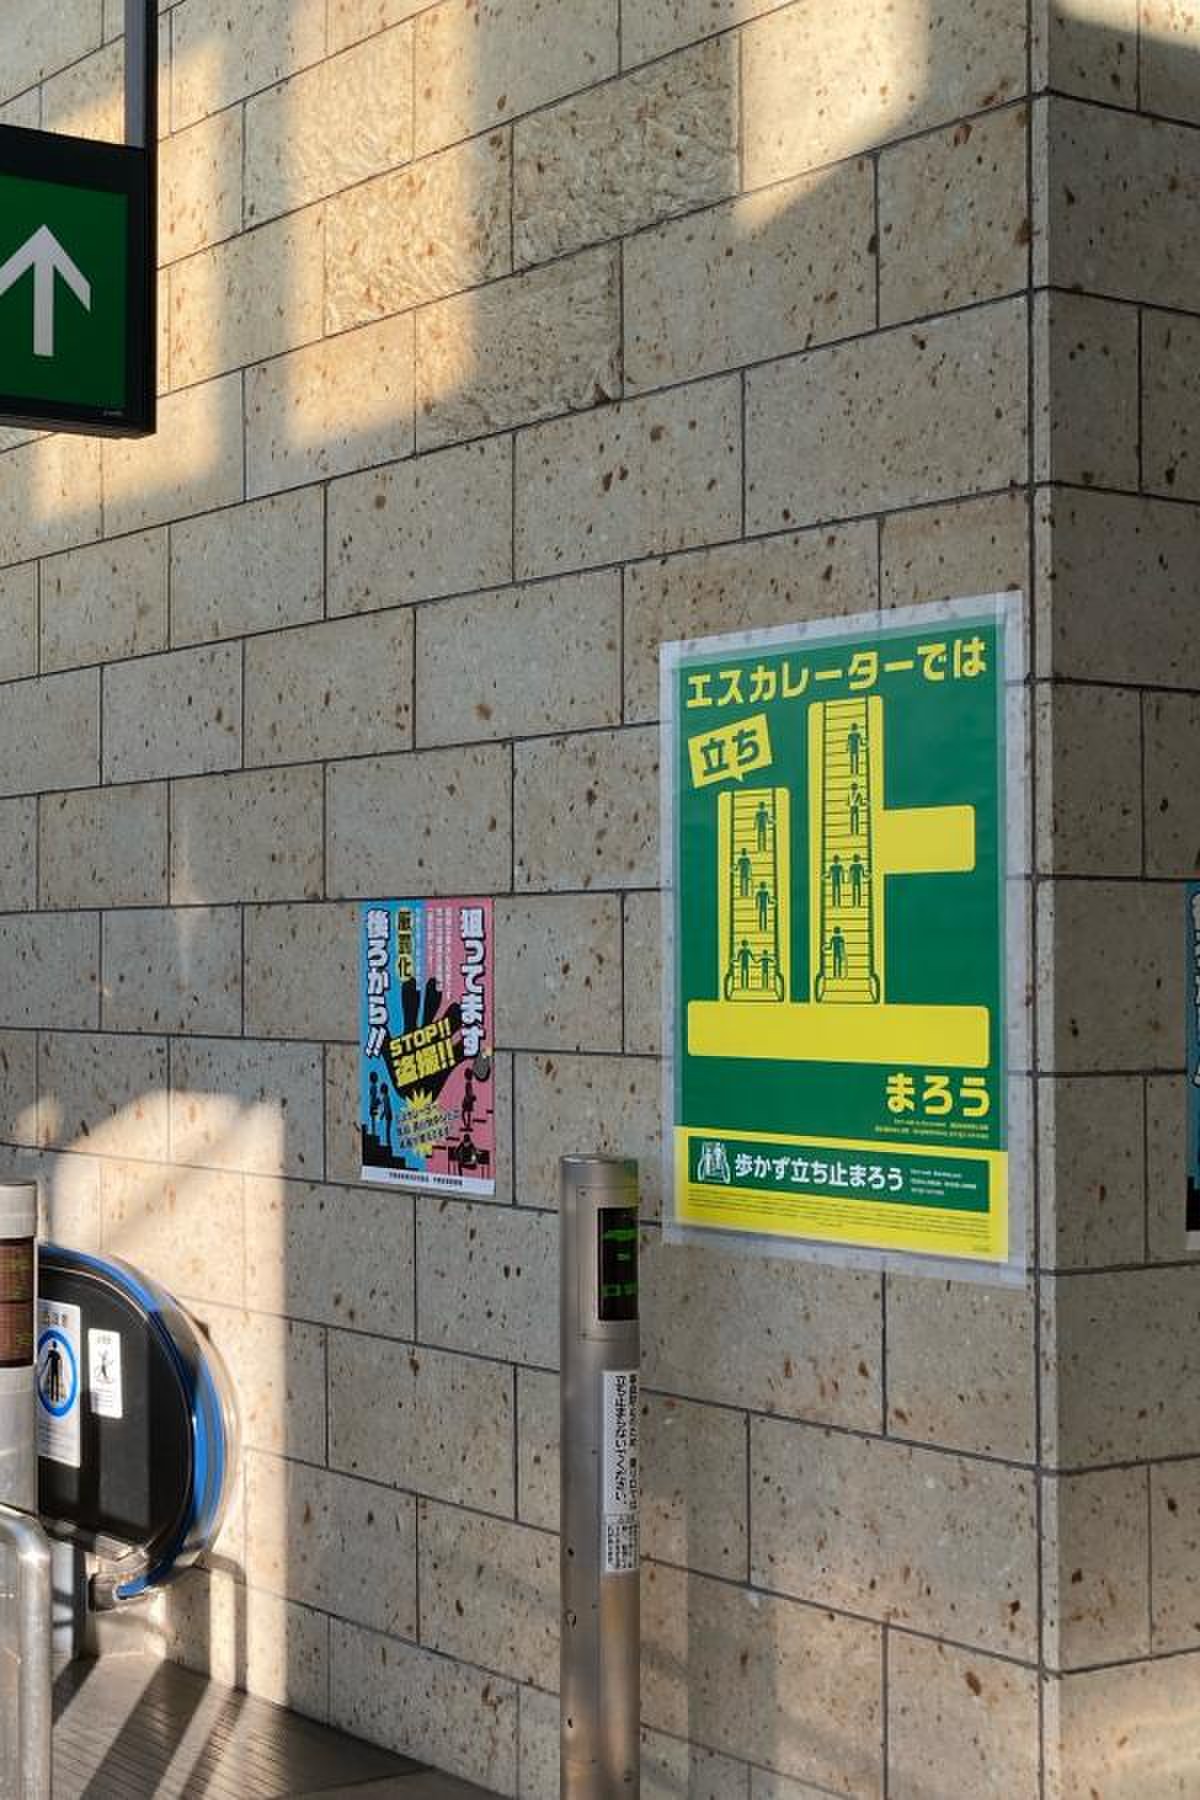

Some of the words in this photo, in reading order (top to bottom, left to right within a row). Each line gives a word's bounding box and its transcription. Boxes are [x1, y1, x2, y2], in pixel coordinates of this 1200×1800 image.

[686, 636, 987, 709] エスカレーターでは
[699, 727, 761, 778] 立ち
[885, 1072, 991, 1118] まろう
[734, 1152, 904, 1192] 歩かず立ち止まろう
